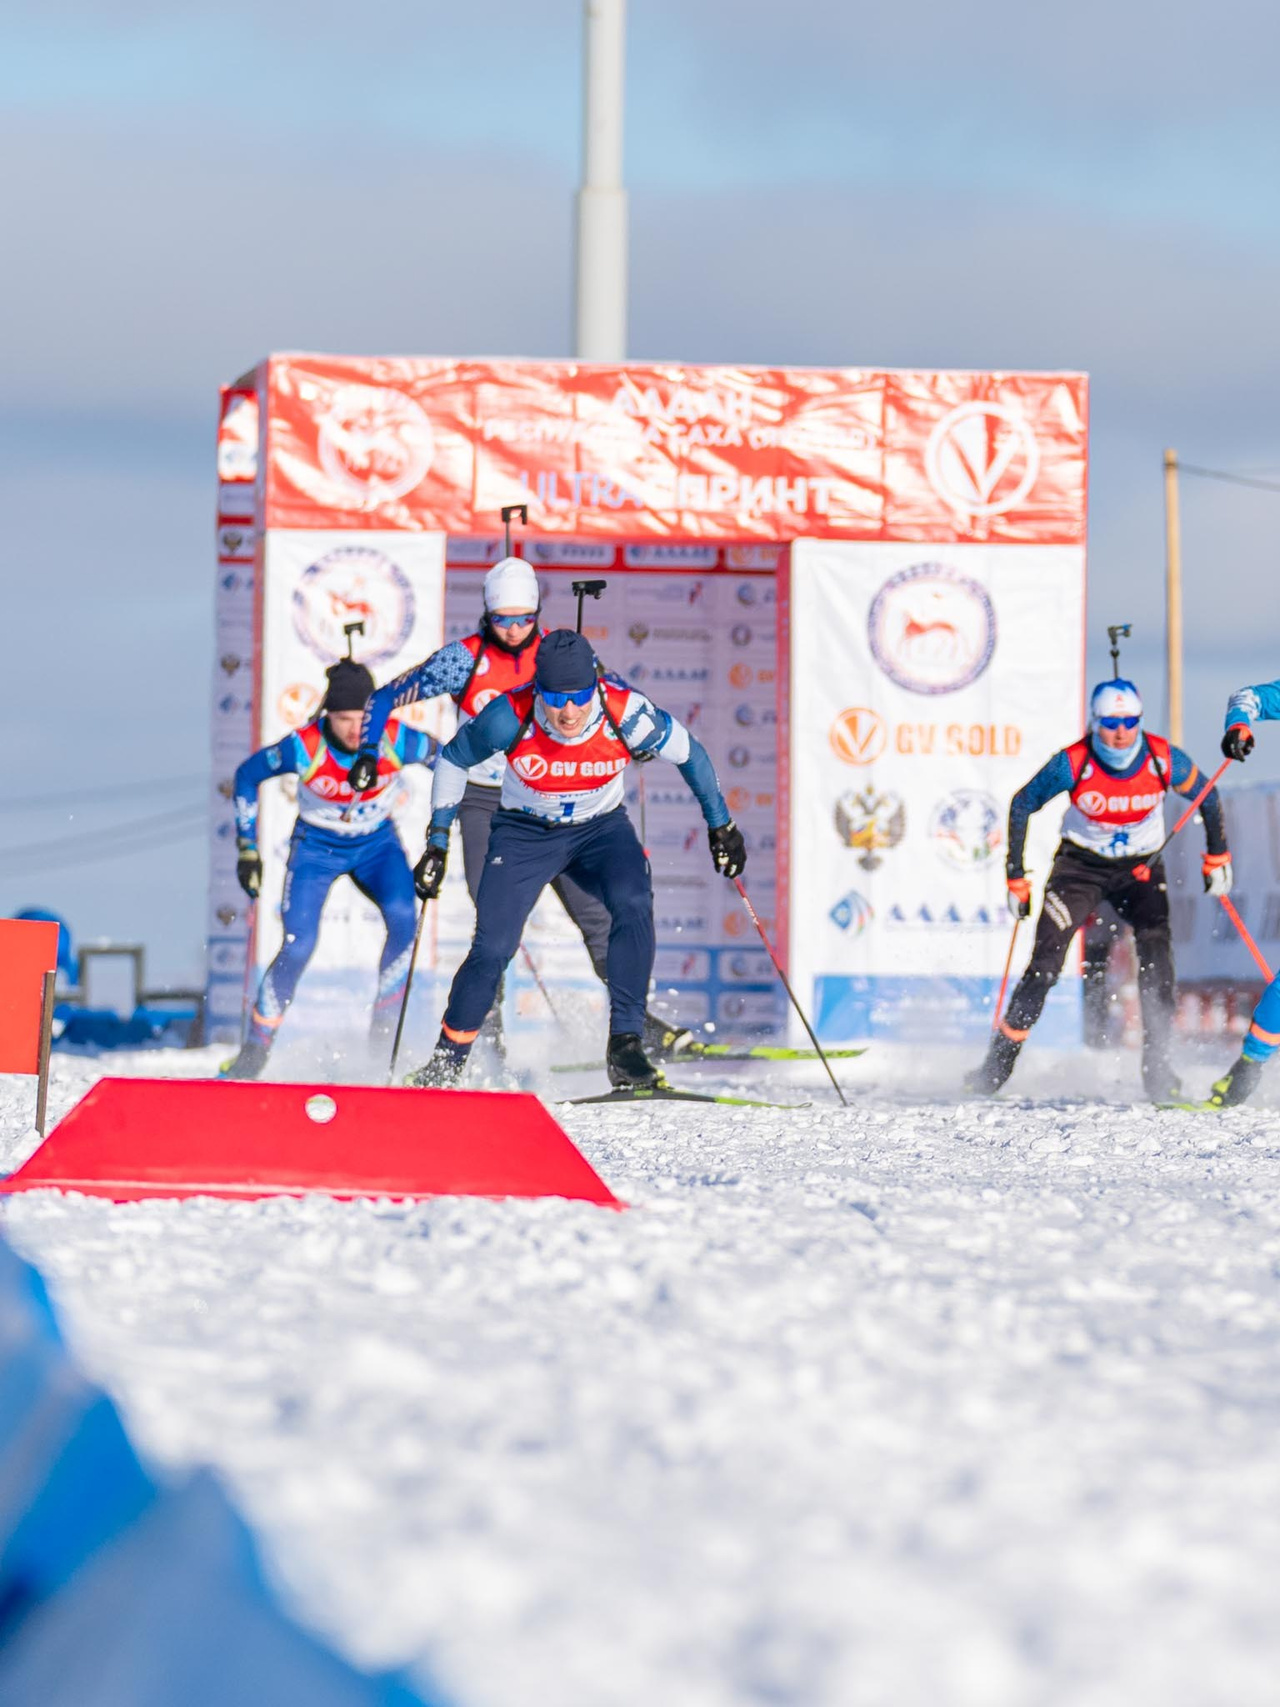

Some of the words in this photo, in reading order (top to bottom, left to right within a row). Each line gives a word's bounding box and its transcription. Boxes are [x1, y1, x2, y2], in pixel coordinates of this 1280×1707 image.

[895, 722, 938, 756] GV
[946, 722, 1022, 757] GOLD
[550, 760, 578, 777] GV
[559, 801, 576, 817] 1
[1107, 795, 1130, 812] GV
